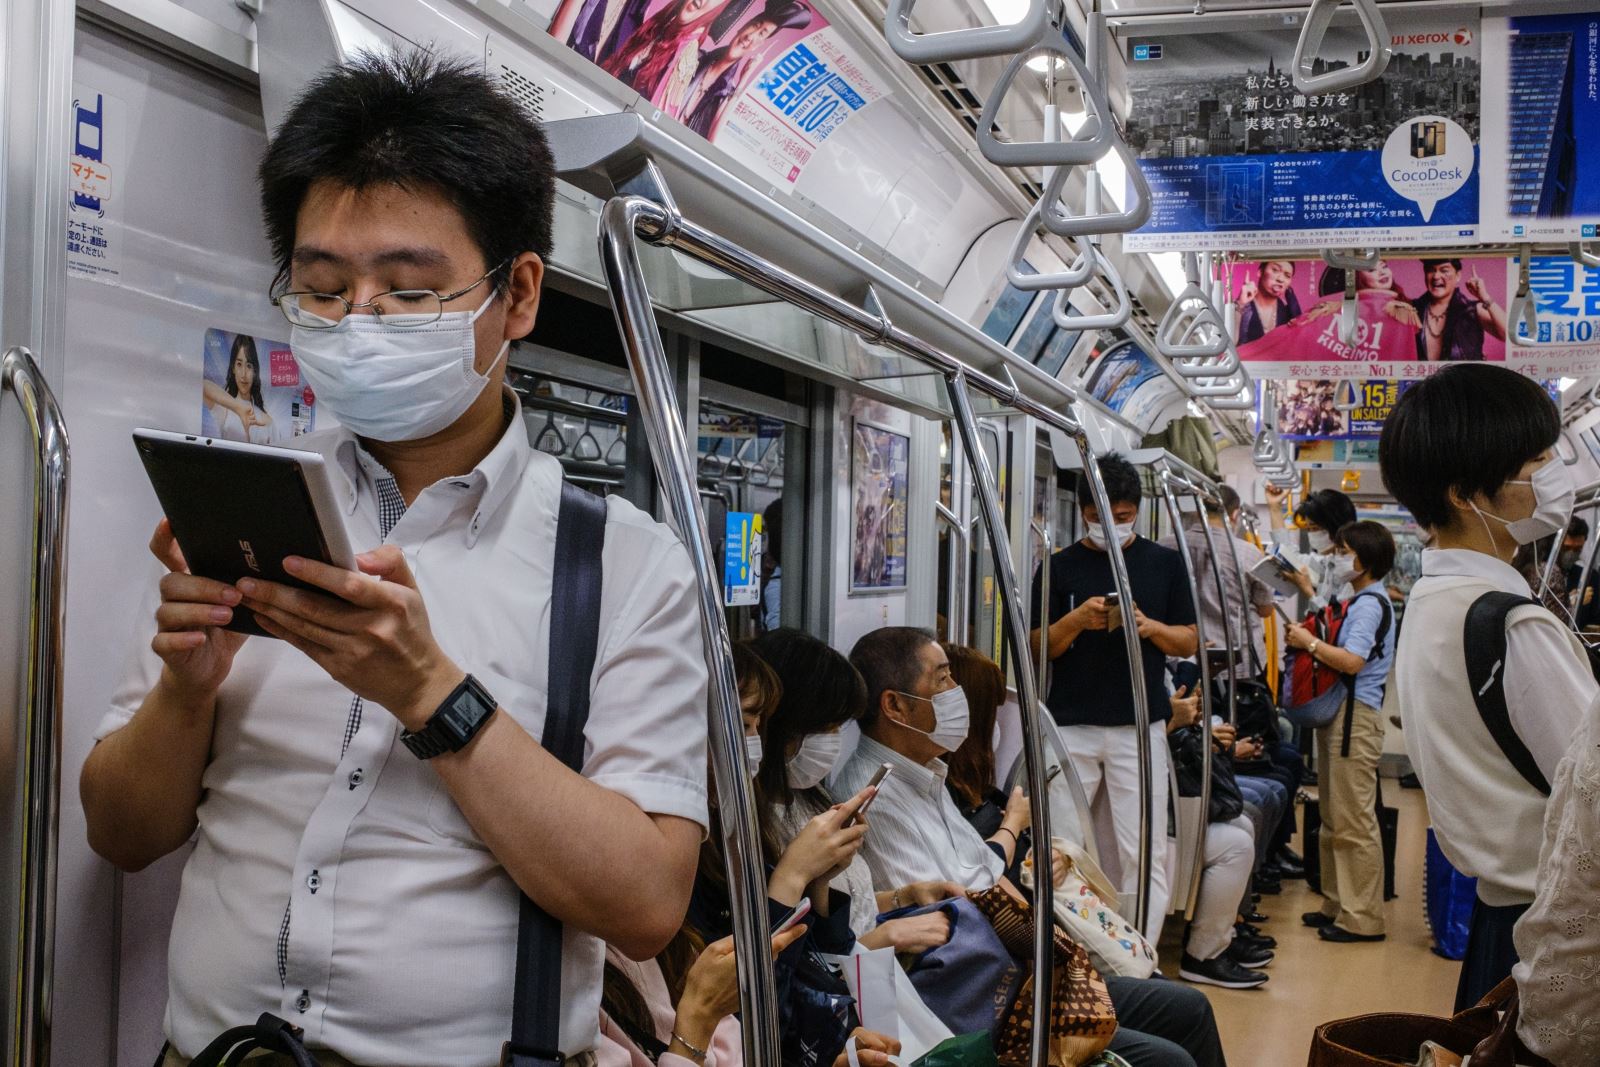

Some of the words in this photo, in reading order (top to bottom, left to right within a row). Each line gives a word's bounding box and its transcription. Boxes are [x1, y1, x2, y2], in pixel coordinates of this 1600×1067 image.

[1408, 32, 1449, 44] xerox
[1245, 75, 1296, 89] 私たち
[1245, 92, 1349, 111] 新しい働き方を
[798, 95, 840, 132] 10
[1245, 115, 1341, 131] 実装できるか。
[71, 162, 107, 181] マナー
[1391, 167, 1463, 182] CocoDesk
[81, 182, 97, 192] モード
[1303, 211, 1416, 220] もうひとつの快適オフィス空間を。
[1513, 256, 1600, 316] 夏
[1566, 320, 1592, 342] 10
[1317, 334, 1379, 362] KIREIMO
[1289, 364, 1343, 377] 安心・安全
[1369, 364, 1394, 377] No.1
[1362, 384, 1385, 407] 15
